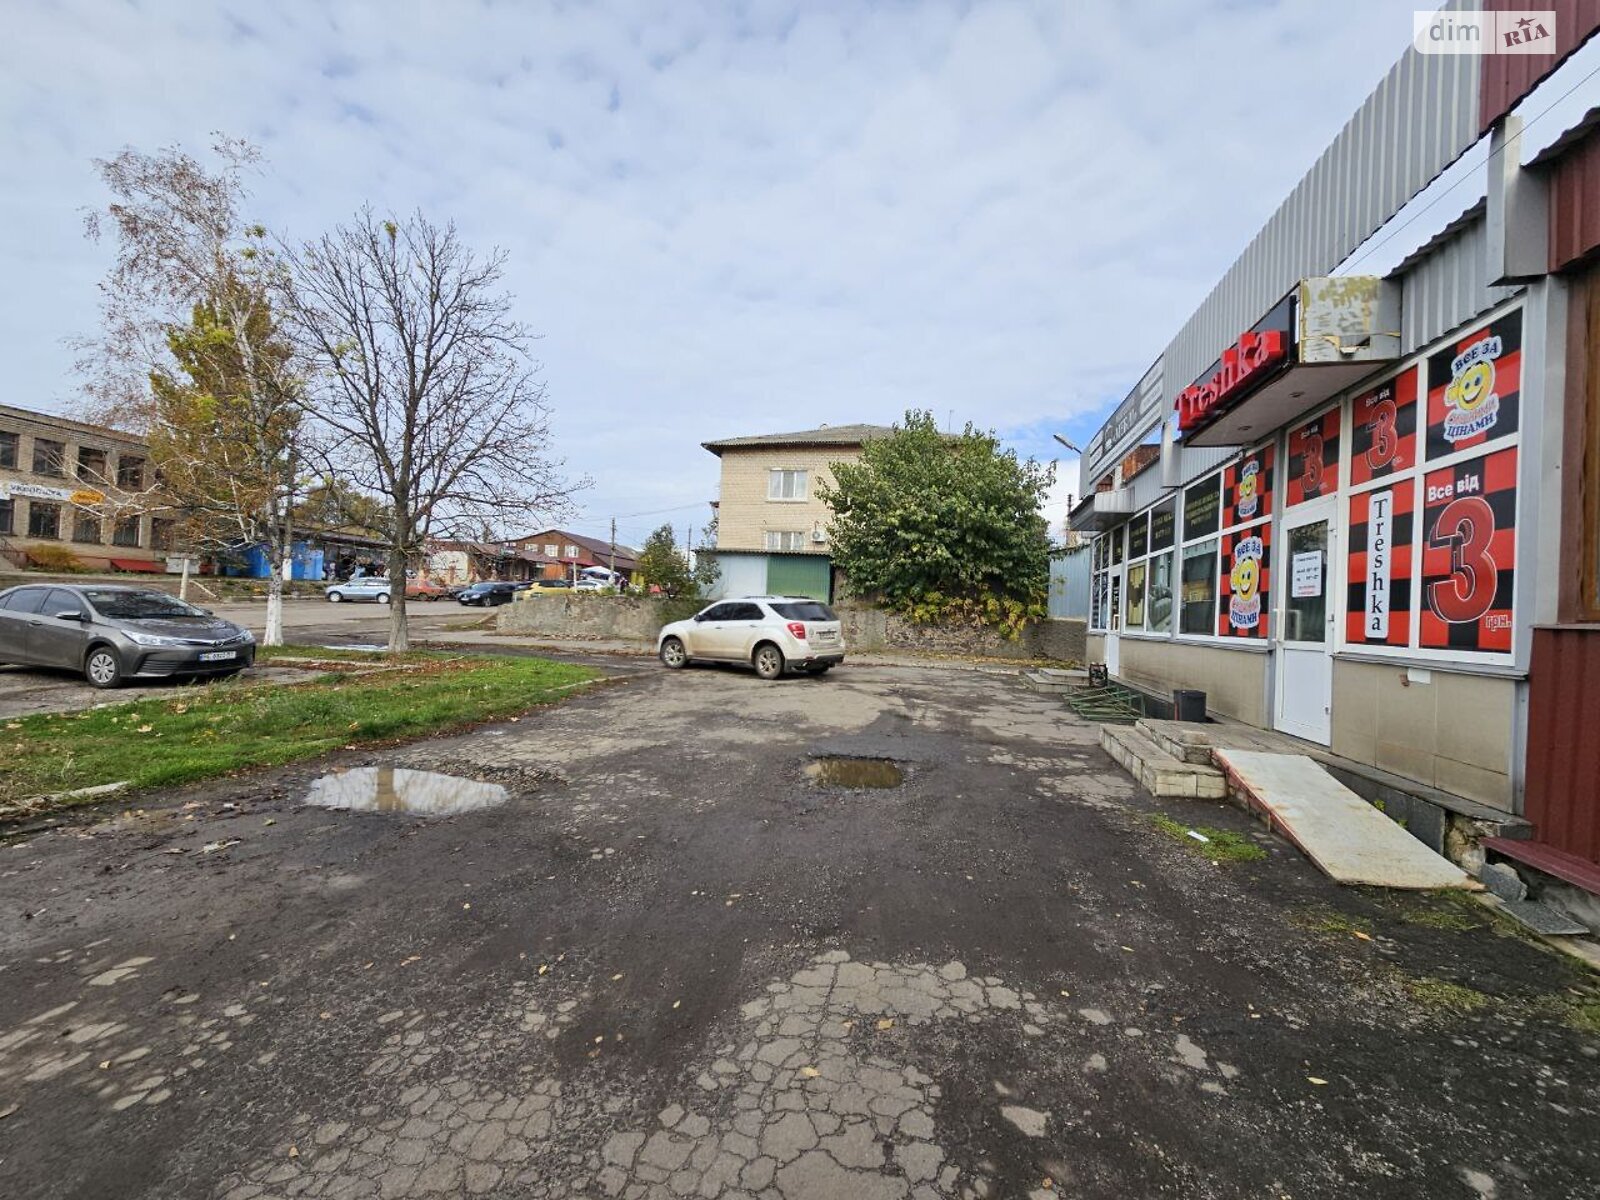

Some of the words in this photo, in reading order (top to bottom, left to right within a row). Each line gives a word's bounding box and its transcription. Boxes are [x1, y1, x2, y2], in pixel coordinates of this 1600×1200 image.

[1454, 346, 1481, 372] ВСЕ
[1481, 341, 1499, 356] ЗА
[1427, 485, 1453, 503] Все
[1456, 474, 1480, 494] від
[1371, 498, 1388, 631] Treshka
[1427, 496, 1498, 624] 3
[1485, 614, 1512, 632] грн.
